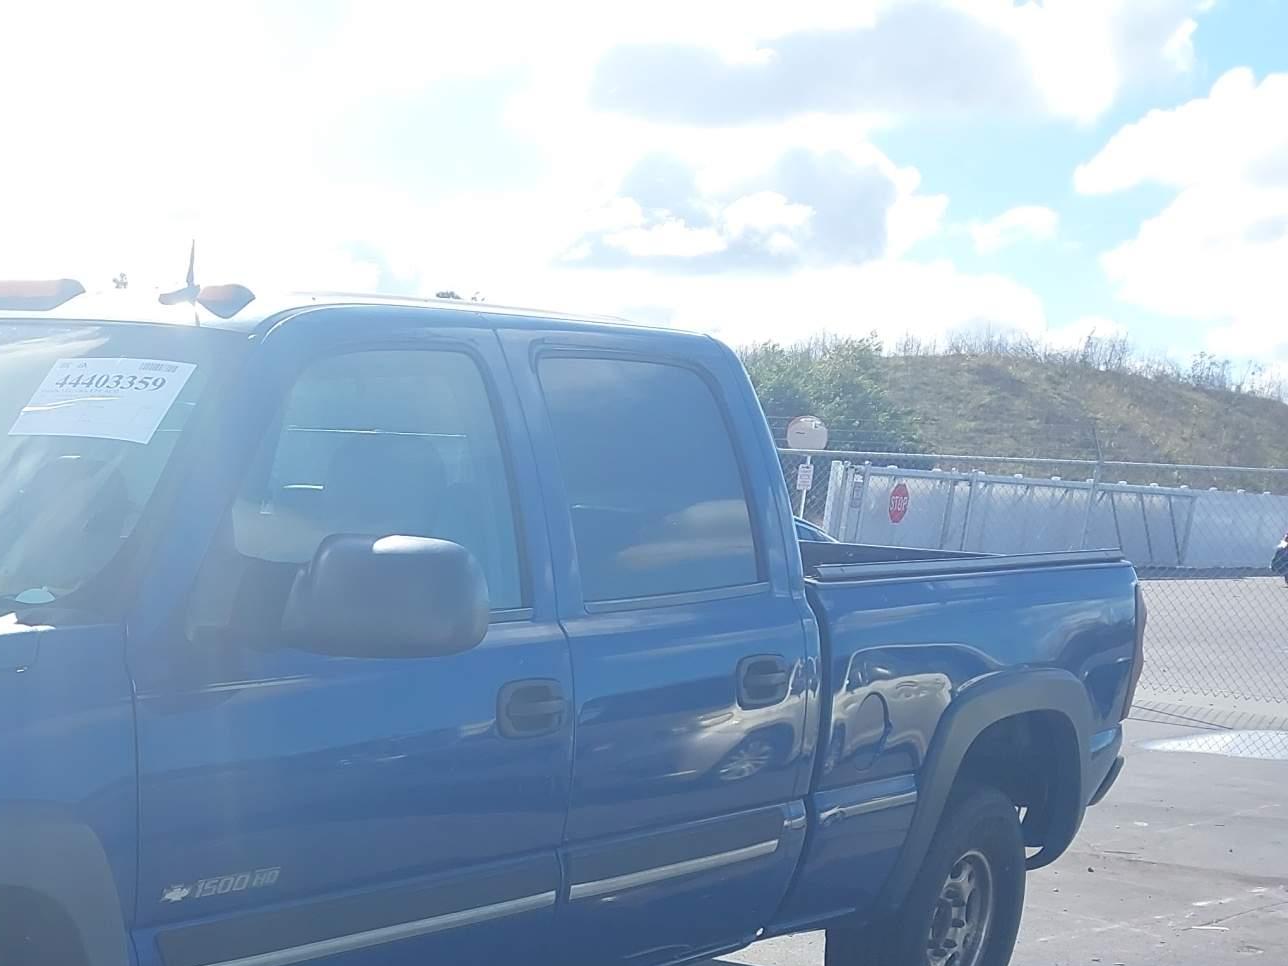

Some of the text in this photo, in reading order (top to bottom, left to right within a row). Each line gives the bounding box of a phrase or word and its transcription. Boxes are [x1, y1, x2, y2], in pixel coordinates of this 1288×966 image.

[55, 374, 167, 391] 44403359
[889, 495, 909, 512] STOP
[195, 868, 281, 898] 1500 HD
